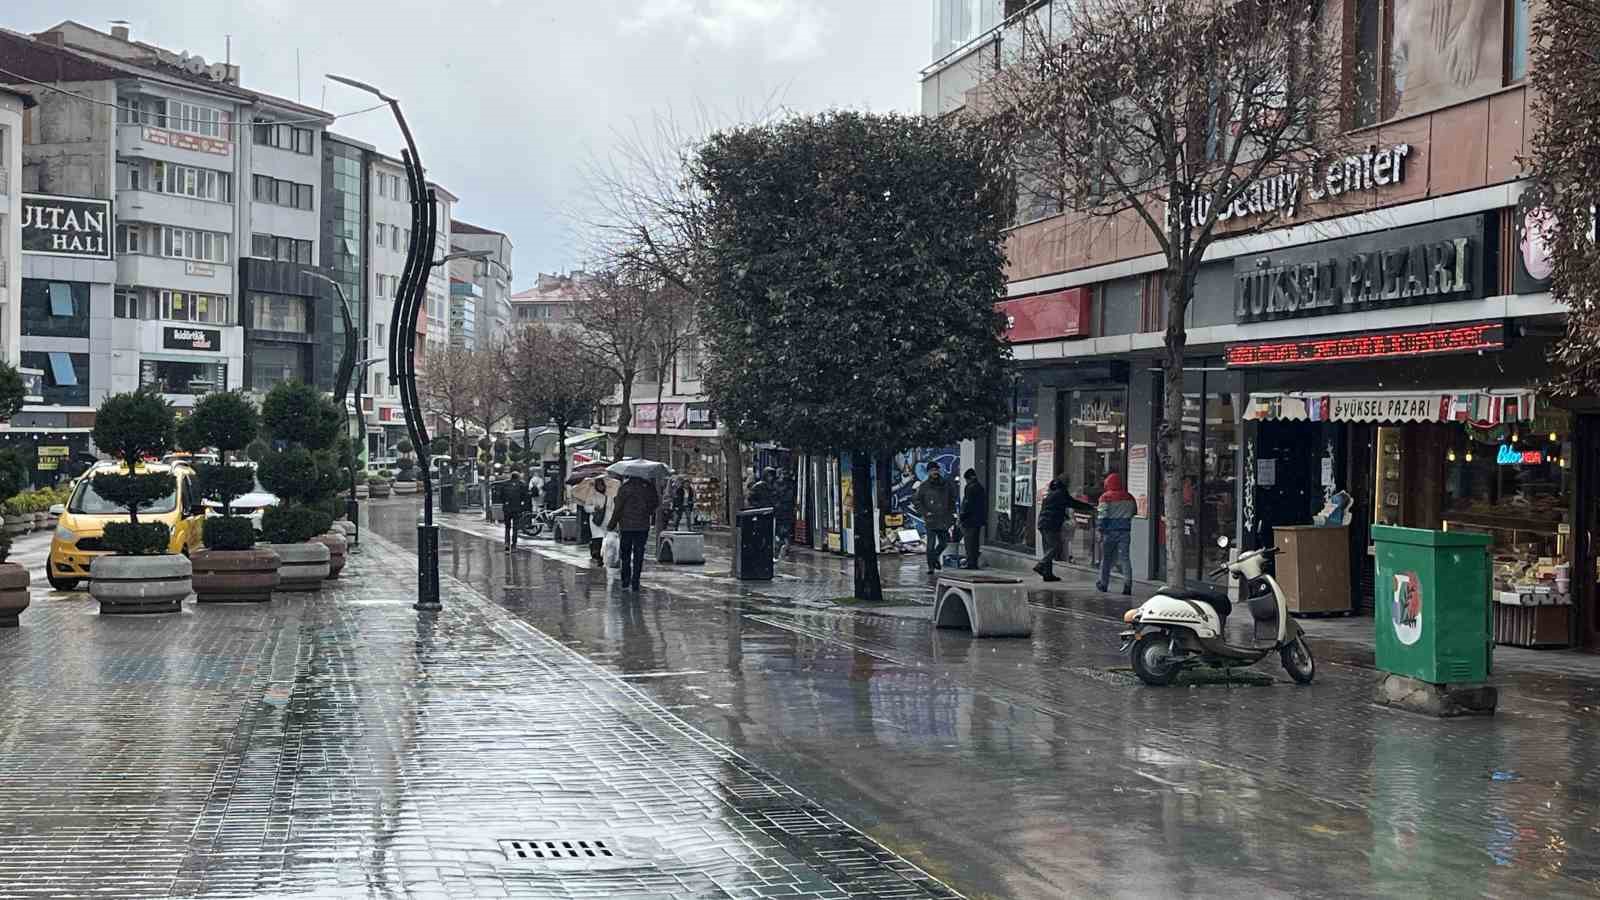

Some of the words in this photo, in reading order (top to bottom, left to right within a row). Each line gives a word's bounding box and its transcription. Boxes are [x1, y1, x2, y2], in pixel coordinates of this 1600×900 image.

[1308, 143, 1410, 201] Center
[52, 234, 104, 252] HALI
[1233, 257, 1336, 317] YÜKSEL
[1343, 238, 1470, 304] PAZARI
[1344, 399, 1384, 418] YÜKSEL
[1388, 399, 1431, 417] PAZARI
